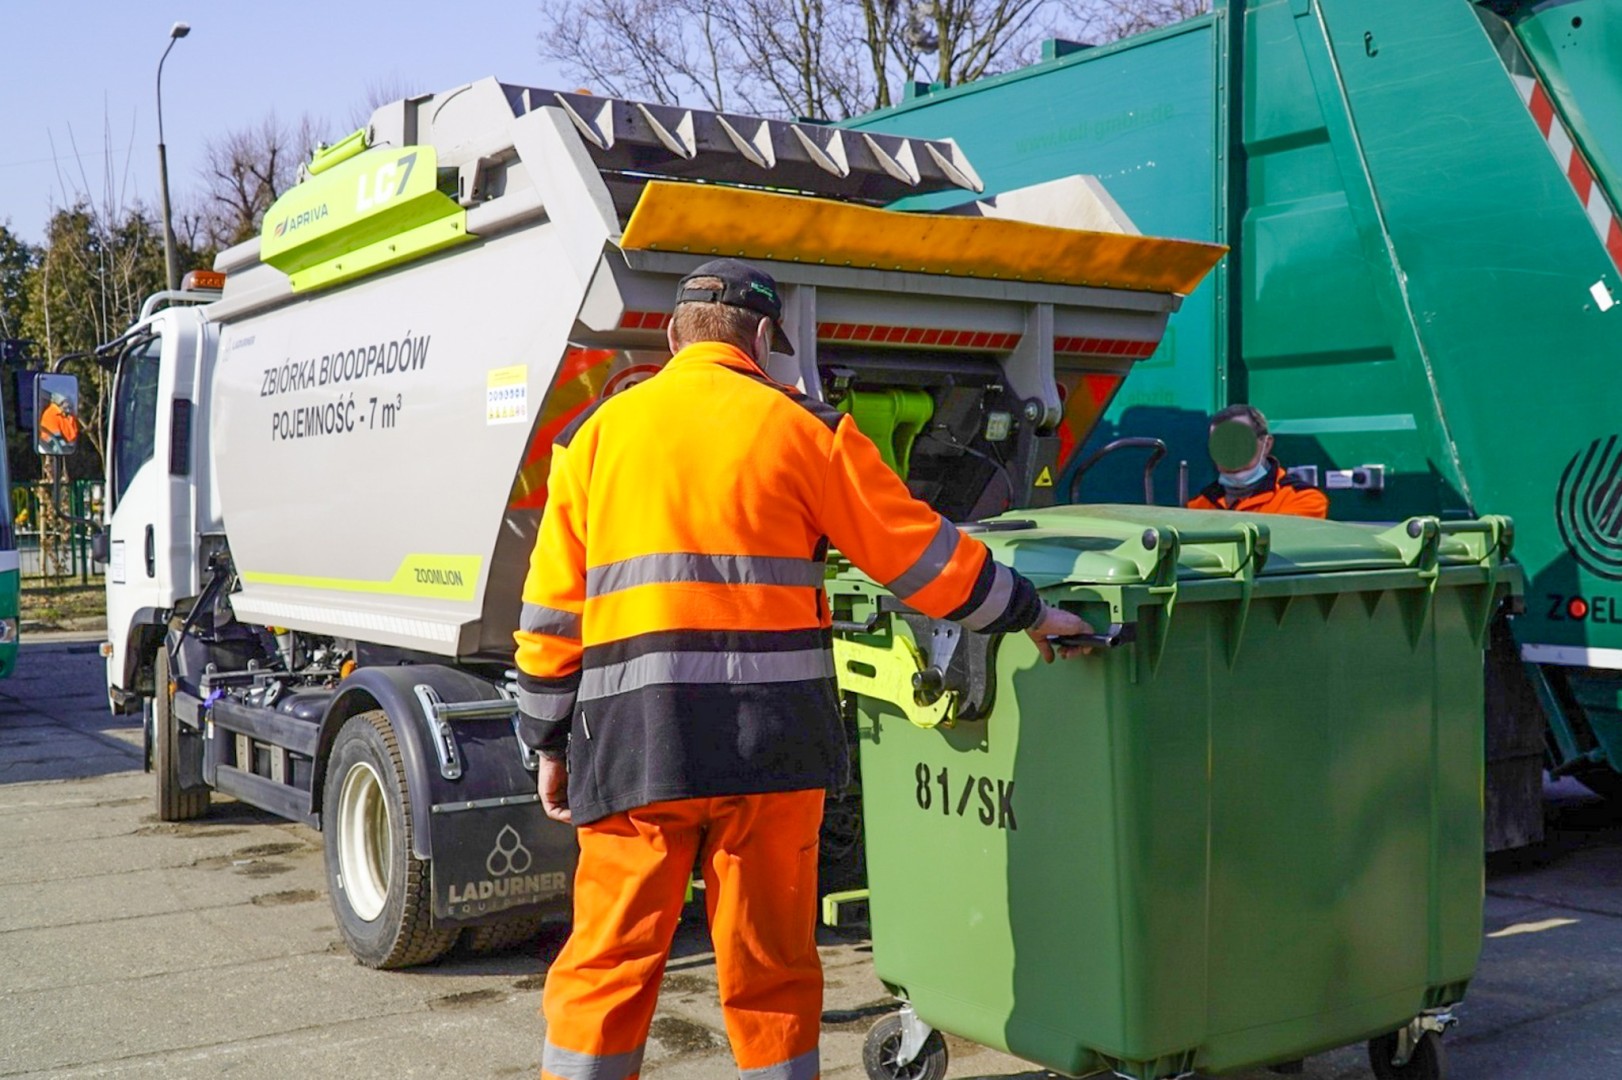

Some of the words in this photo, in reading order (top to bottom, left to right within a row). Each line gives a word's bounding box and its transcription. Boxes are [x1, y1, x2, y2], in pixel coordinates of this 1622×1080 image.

[355, 152, 418, 214] LC7
[289, 203, 329, 232] APRIVA
[260, 357, 316, 398] ZBIÓRKA
[318, 329, 431, 387] BIOODPADÓW
[272, 391, 355, 442] POJEMNOŚĆ
[369, 397, 378, 430] 7
[413, 567, 464, 587] ZOOMLION
[915, 762, 1017, 831] 81/SK
[448, 871, 566, 904] LADURNER
